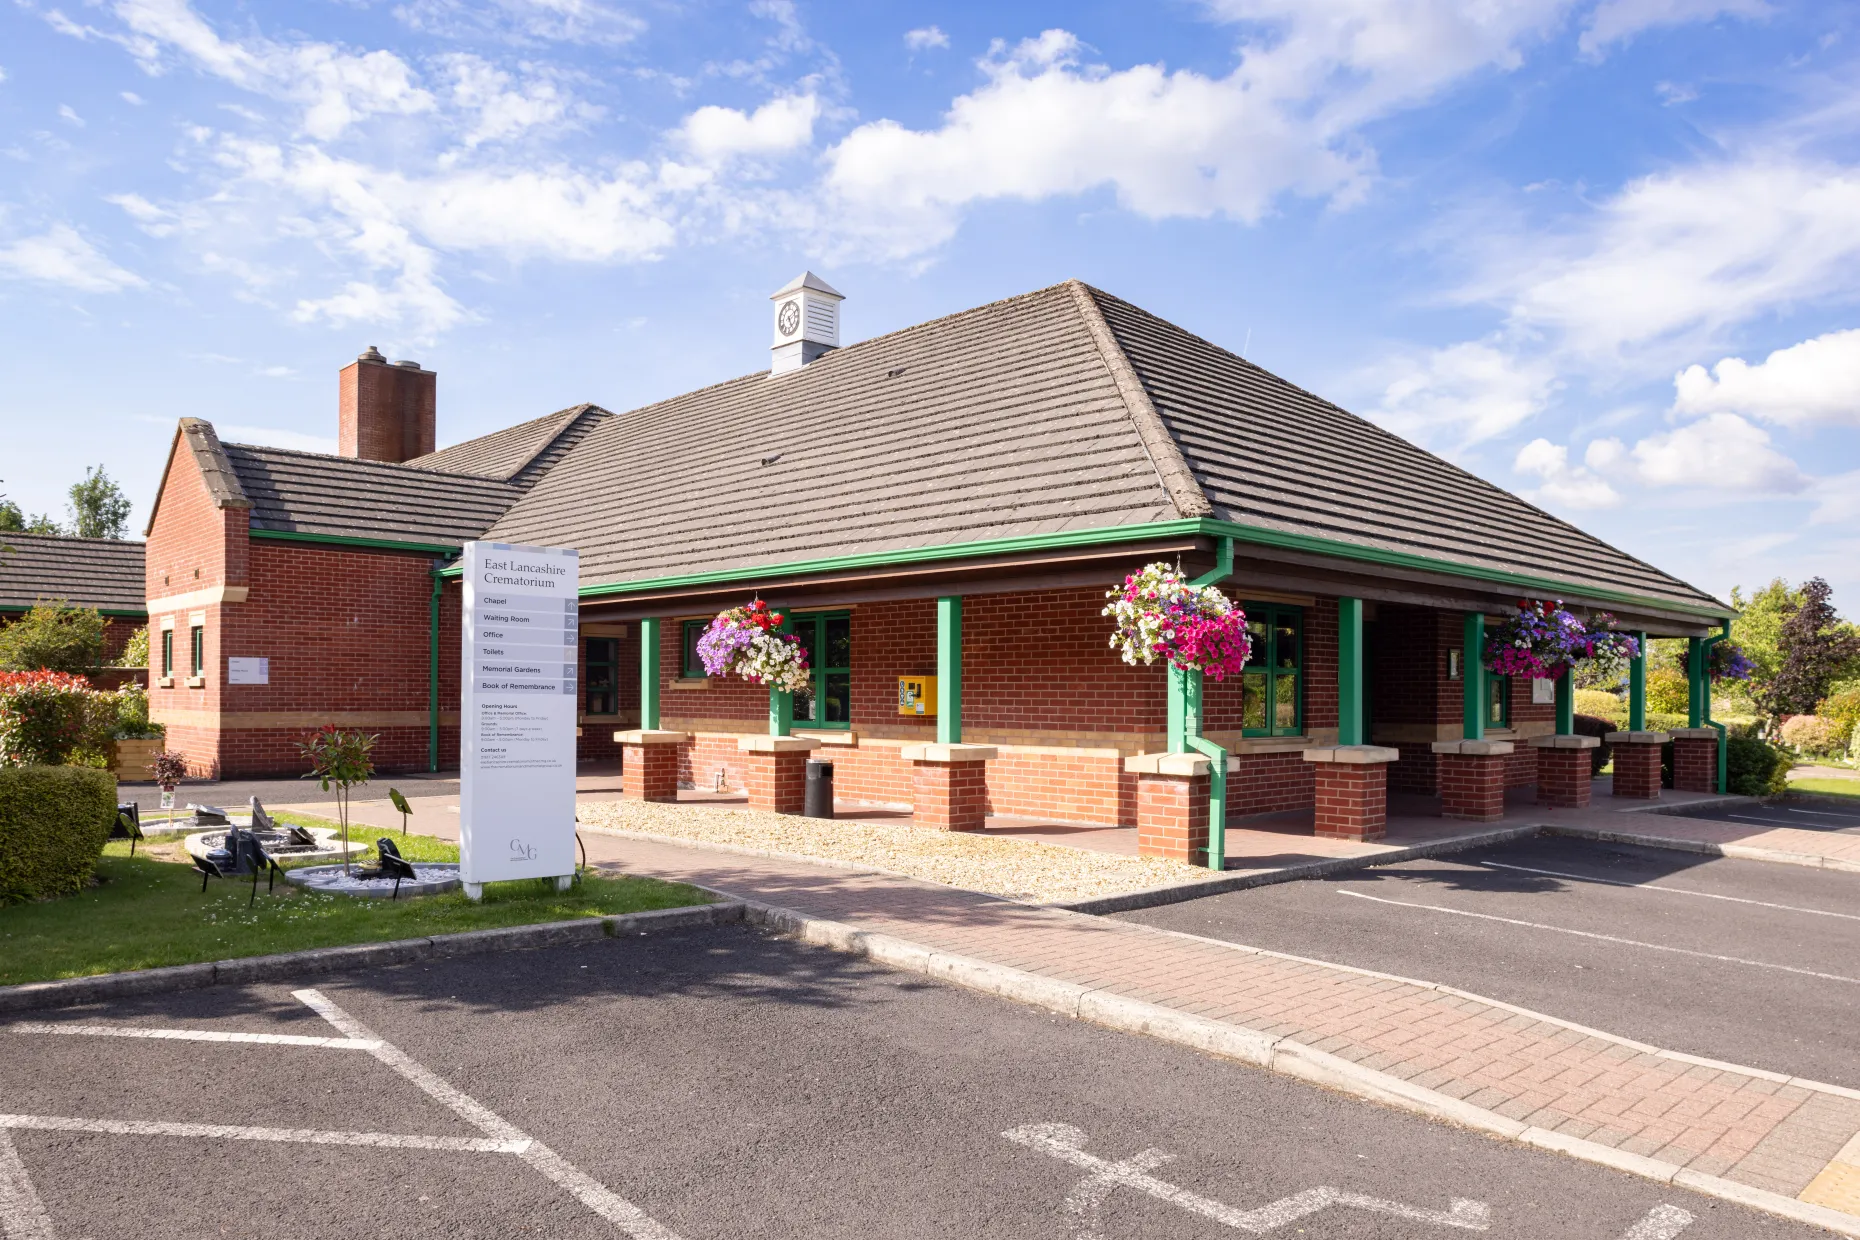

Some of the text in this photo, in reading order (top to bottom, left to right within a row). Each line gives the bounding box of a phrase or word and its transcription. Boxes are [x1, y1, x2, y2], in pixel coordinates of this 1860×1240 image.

[485, 558, 566, 576] East Lancashire
[484, 572, 555, 588] Crematorium
[484, 597, 506, 605] Chapel
[484, 614, 508, 622] Waiting
